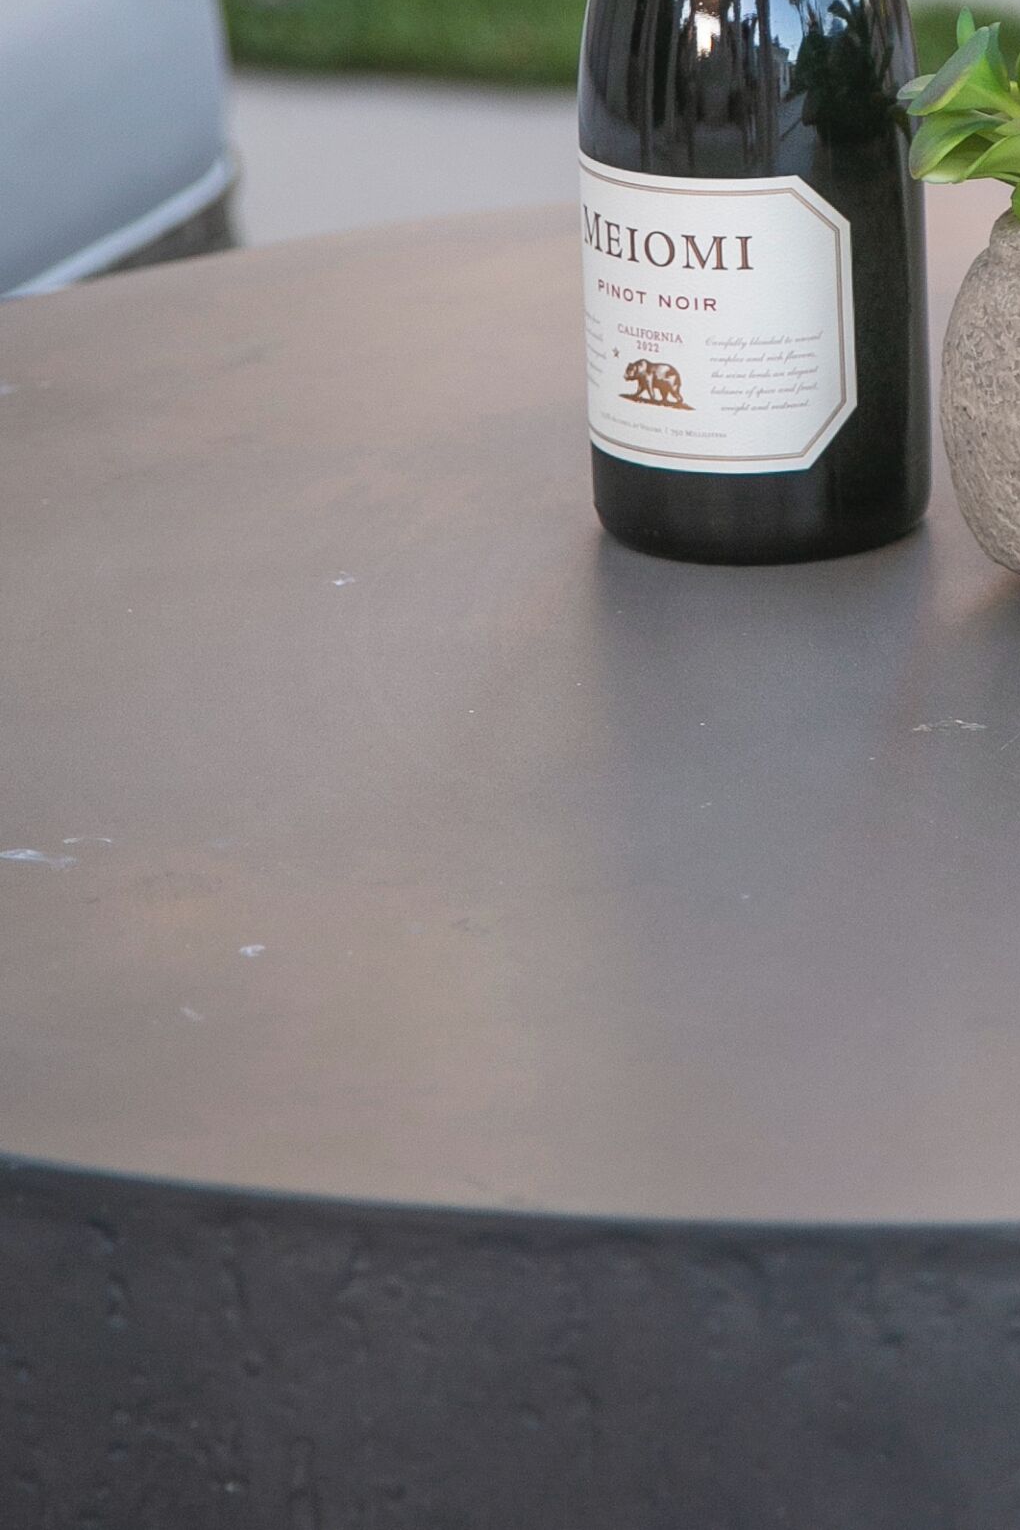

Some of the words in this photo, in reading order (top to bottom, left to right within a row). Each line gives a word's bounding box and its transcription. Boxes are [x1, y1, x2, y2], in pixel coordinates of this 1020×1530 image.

[583, 204, 755, 271] MEIOMI
[597, 278, 647, 305] PINOT
[658, 293, 718, 312] NOIR
[617, 323, 684, 344] CALIFORNIA
